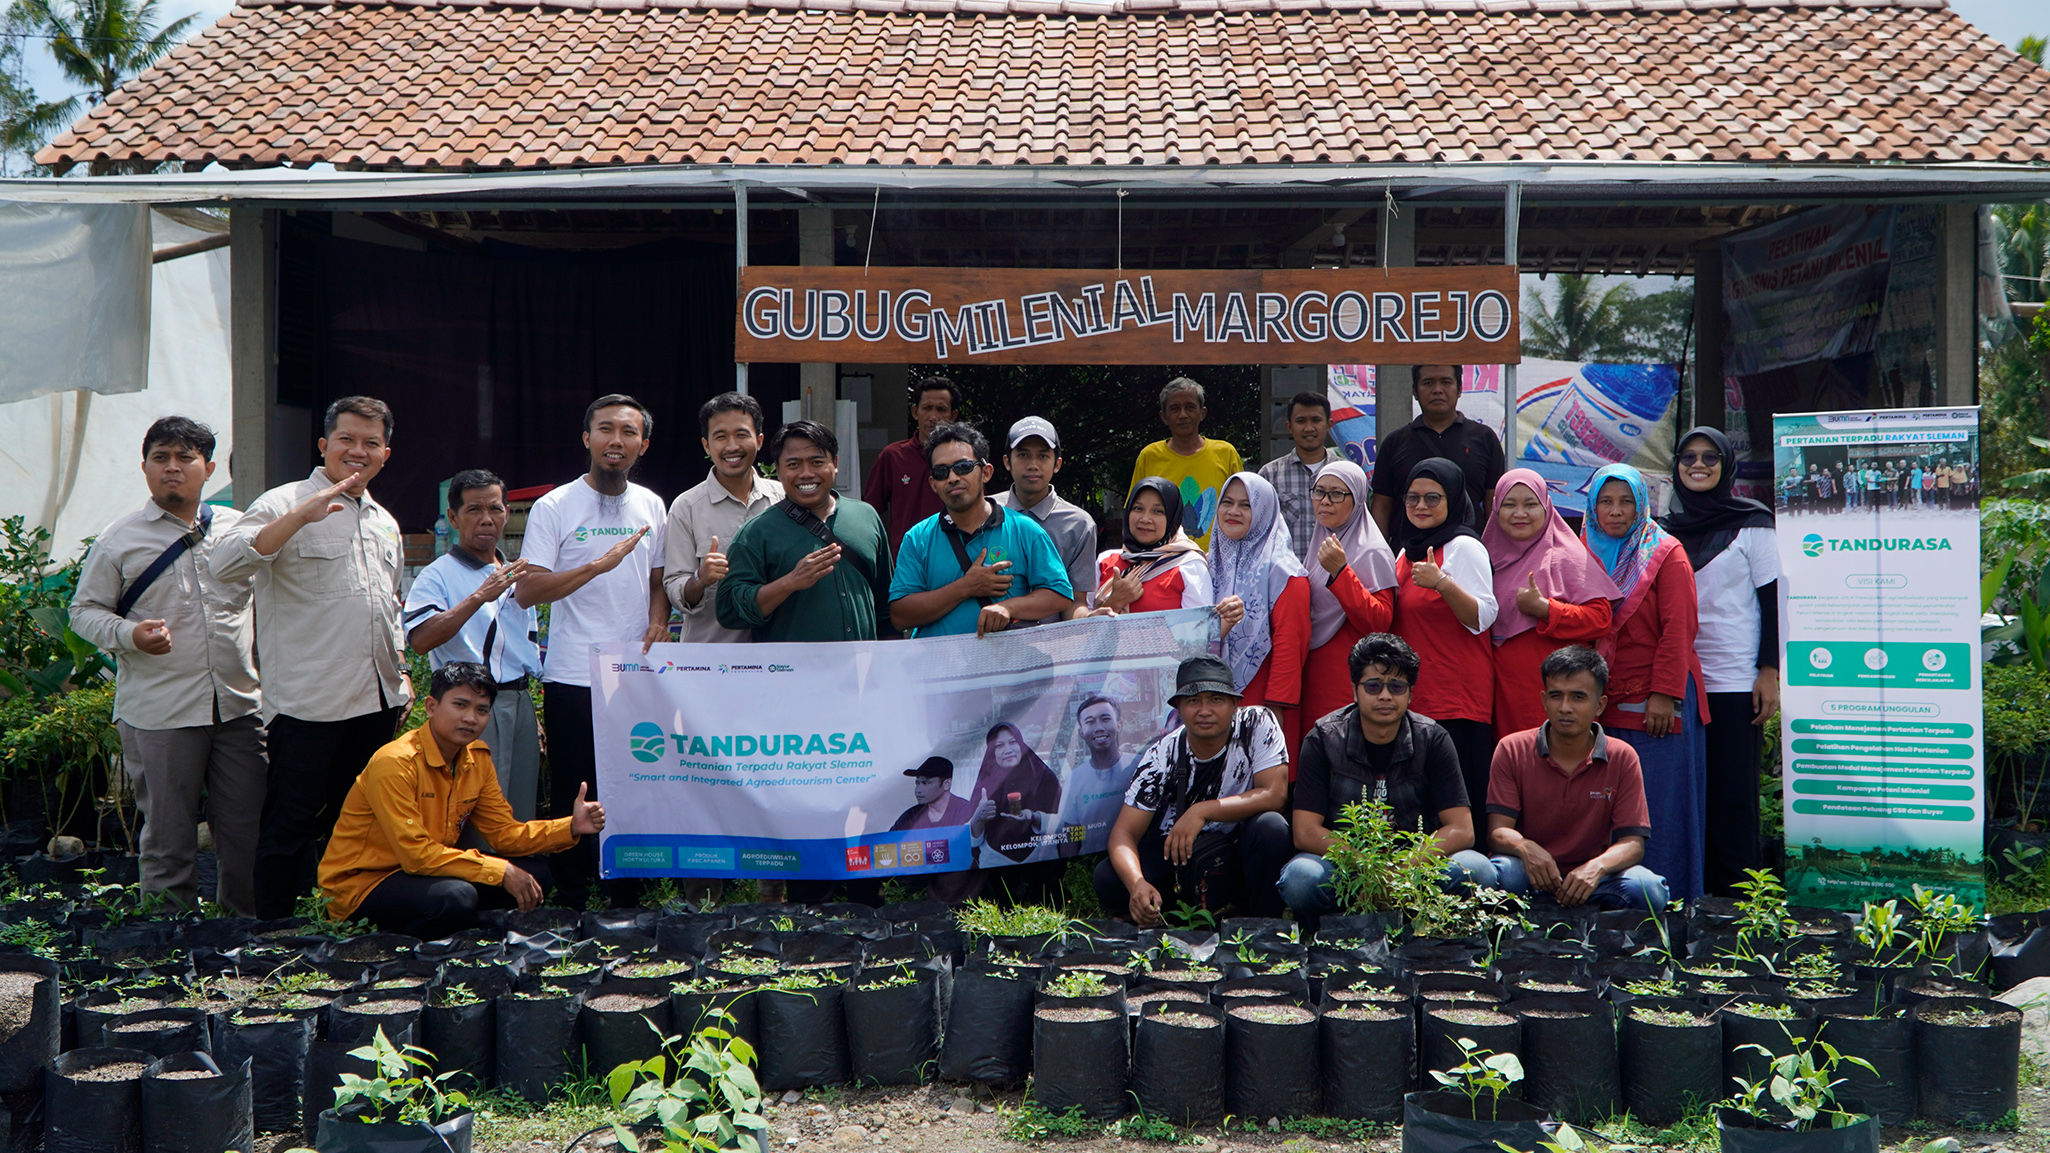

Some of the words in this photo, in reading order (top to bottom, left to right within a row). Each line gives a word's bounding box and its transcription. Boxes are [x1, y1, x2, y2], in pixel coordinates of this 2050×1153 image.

[1768, 224, 1832, 262] PELATIHAN
[1780, 258, 1823, 287] PETANI
[742, 286, 932, 342] GUBUG
[932, 275, 1173, 359] MILENIAL
[1173, 289, 1511, 343] MARGOREJO
[1786, 436, 1838, 444] PERTANIAN
[1840, 435, 1883, 443] TERPADU
[1885, 433, 1925, 441] RAKYAT
[1926, 432, 1965, 440] SLEMAN
[590, 527, 651, 537] TANDURA
[1828, 538, 1952, 551] TANDURASA
[612, 663, 639, 672] BUMN
[670, 732, 871, 757] TANDURASA
[1816, 743, 1850, 751] Pelatihan
[680, 760, 732, 772] Pertanian
[736, 761, 783, 773] Terpadu
[786, 760, 827, 772] Rakyat
[830, 759, 873, 769] Sleman
[1904, 767, 1939, 775] Pertanian
[1940, 769, 1970, 777] Terpadu
[668, 773, 688, 783] and
[690, 775, 743, 787] Integrated
[745, 776, 832, 789] Agroedutourism
[1837, 785, 1876, 793] Kampanye
[1823, 804, 1861, 812] Pendataan
[1862, 806, 1892, 814] Peluang
[1922, 809, 1944, 817] Buyer
[1062, 825, 1086, 834] PETANI
[1087, 822, 1107, 830] MUDA
[1030, 832, 1068, 842] KELOMPOK
[1000, 841, 1038, 851] KELOMPOK
[1040, 838, 1069, 846] WANITA
[742, 853, 797, 861] AGROEDUWISATA
